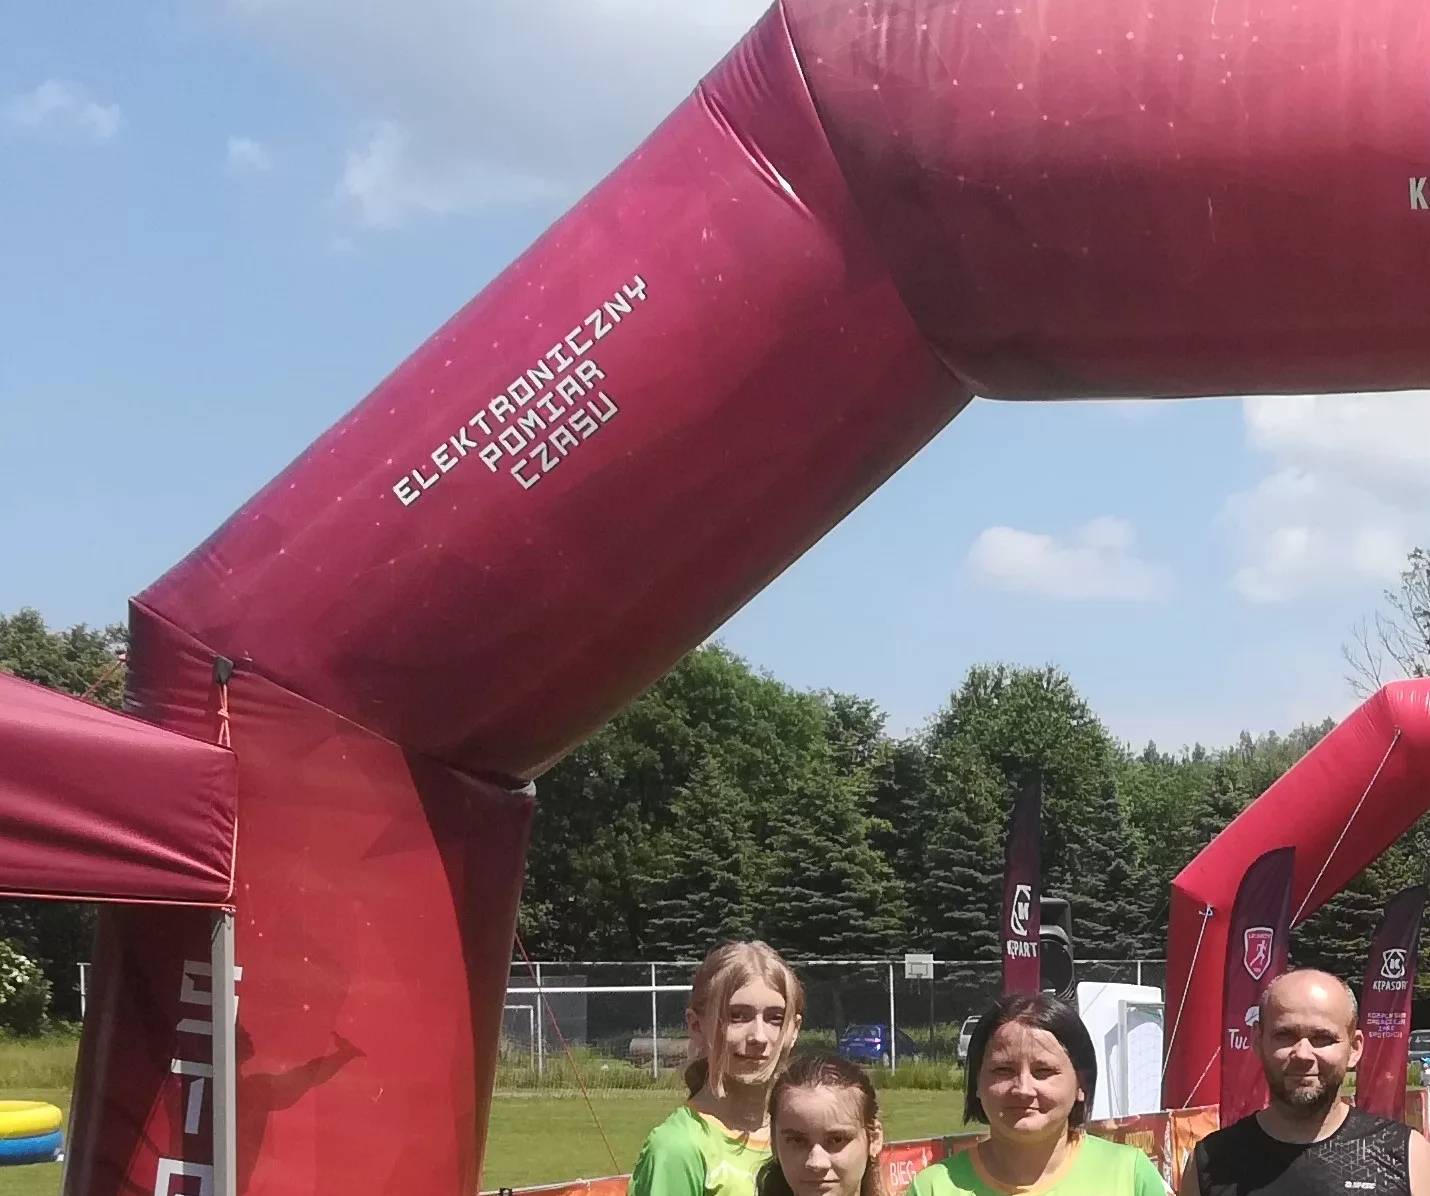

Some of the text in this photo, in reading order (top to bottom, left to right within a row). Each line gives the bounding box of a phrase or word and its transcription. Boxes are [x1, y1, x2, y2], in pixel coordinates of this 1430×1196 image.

[392, 274, 648, 506] ELEKTRONICZNY
[478, 359, 606, 473] POMIAR
[510, 391, 619, 489] CZASU
